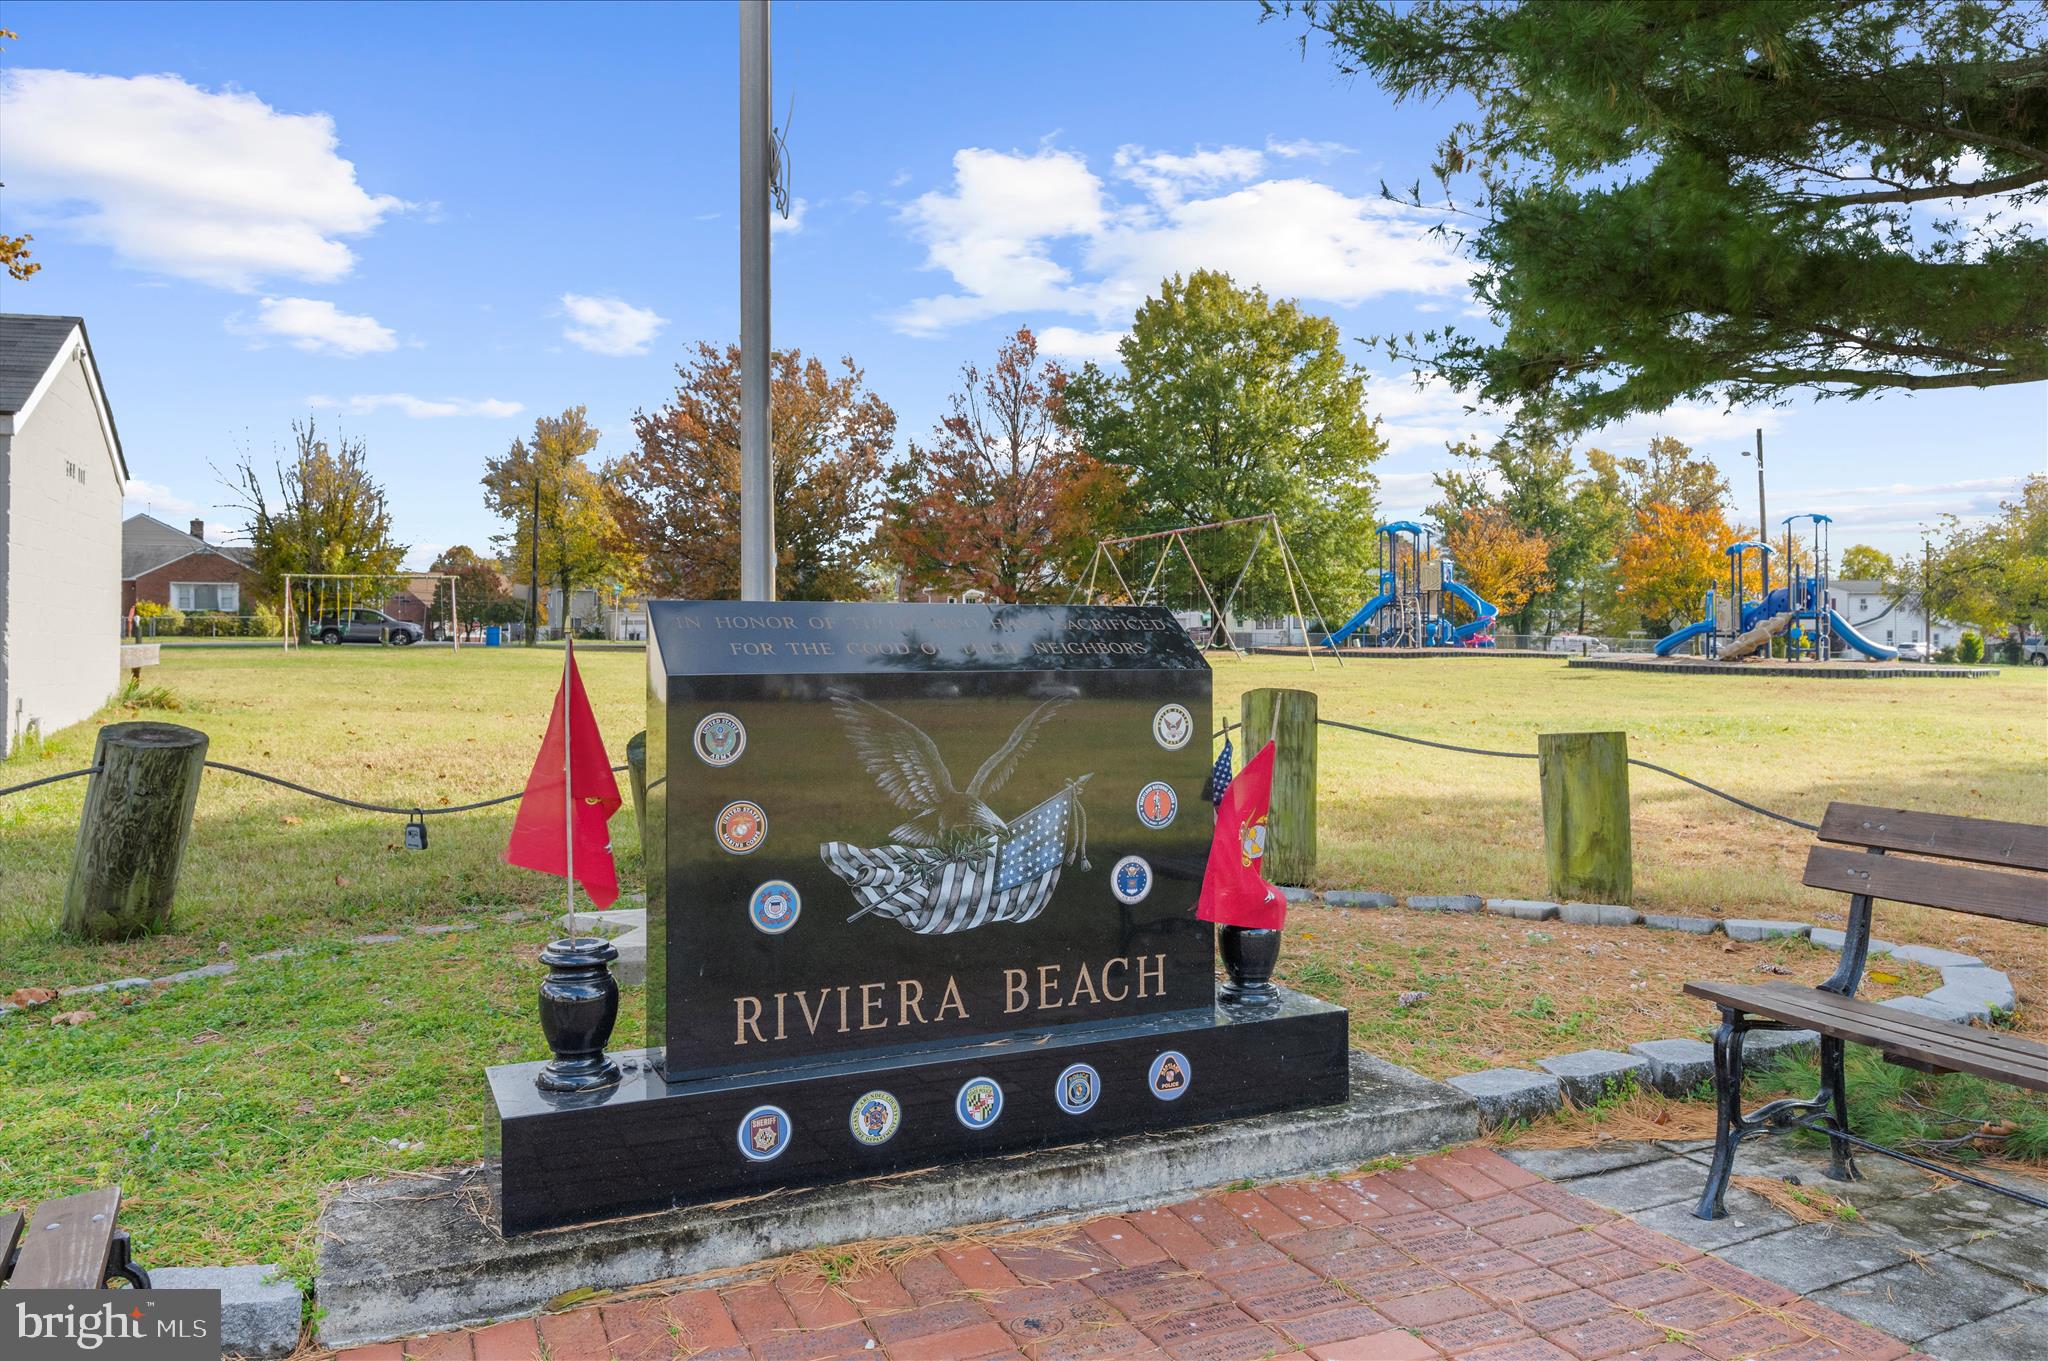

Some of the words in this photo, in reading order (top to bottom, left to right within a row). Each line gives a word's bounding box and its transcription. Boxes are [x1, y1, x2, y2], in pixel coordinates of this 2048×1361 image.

[715, 616, 799, 631] HONOR
[807, 616, 838, 631] OF
[1059, 617, 1166, 632] SACRIFICED
[729, 642, 777, 657] FOR
[784, 642, 835, 657] THE
[846, 642, 910, 657] GOOD
[1031, 641, 1149, 658] NEIGHBORS
[702, 718, 721, 734] UNITED
[721, 718, 740, 734] STATES
[710, 751, 732, 760] ARMY
[722, 807, 742, 825] UNITED
[742, 807, 761, 822] STATES
[723, 833, 744, 848] MARINE
[733, 975, 970, 1046] RIVIERA
[1003, 953, 1167, 1014] BEACH
[1161, 1081, 1180, 1089] POLICE
[752, 1116, 777, 1128] SHERIFF
[1174, 1303, 1236, 1323] LOCKWOOD
[1183, 1316, 1249, 1337] REVOLUTION
